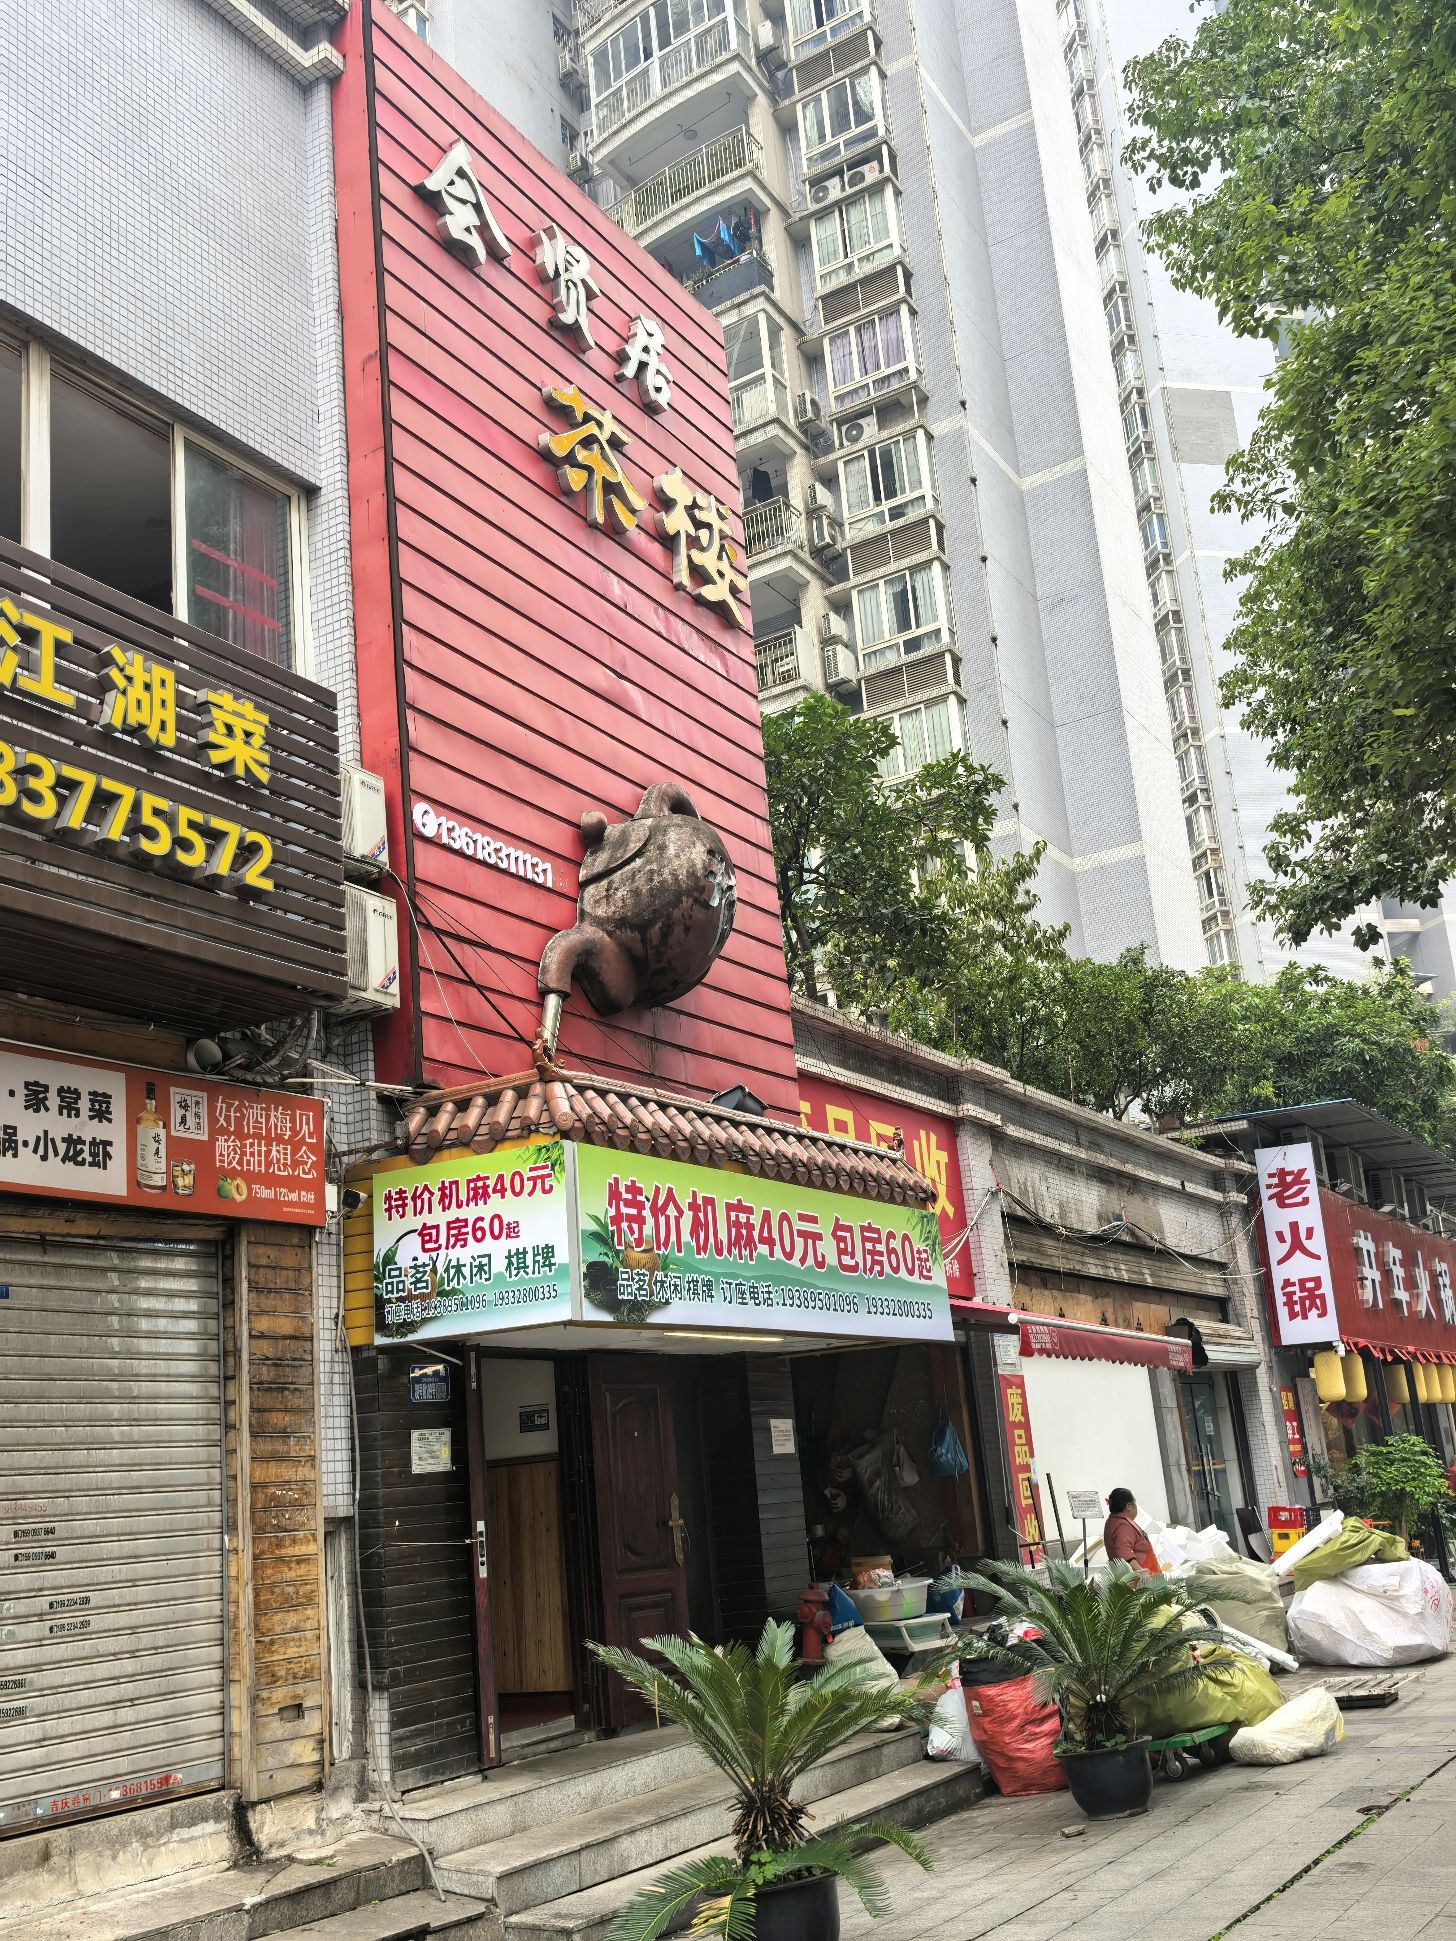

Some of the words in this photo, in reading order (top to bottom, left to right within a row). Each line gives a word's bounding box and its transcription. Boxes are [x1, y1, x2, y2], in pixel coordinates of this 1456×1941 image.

[0, 596, 271, 785] 江湖菜
[437, 815, 553, 888] 13618311131
[214, 1096, 318, 1144] 好酒梅见
[214, 1134, 318, 1179] 酸甜想念
[251, 1184, 275, 1200] 750ml
[382, 1163, 555, 1221] 特价机麻40元
[416, 1212, 521, 1254] 包房60起
[606, 1174, 827, 1272] 特价机麻40元
[830, 1213, 934, 1281] 包房60起
[1264, 1167, 1328, 1322] 老火锅
[382, 1263, 432, 1298] 品茗
[443, 1251, 493, 1290] 休闲
[504, 1243, 557, 1281] 棋牌
[492, 1283, 559, 1308] 19332800335
[617, 1269, 650, 1300] 品茗
[651, 1273, 683, 1301] 休闲
[685, 1274, 716, 1304] 棋牌
[720, 1279, 860, 1314] 订座电话:19389501096
[864, 1295, 934, 1320] 19332800335
[1006, 1385, 1042, 1551] 废品回收
